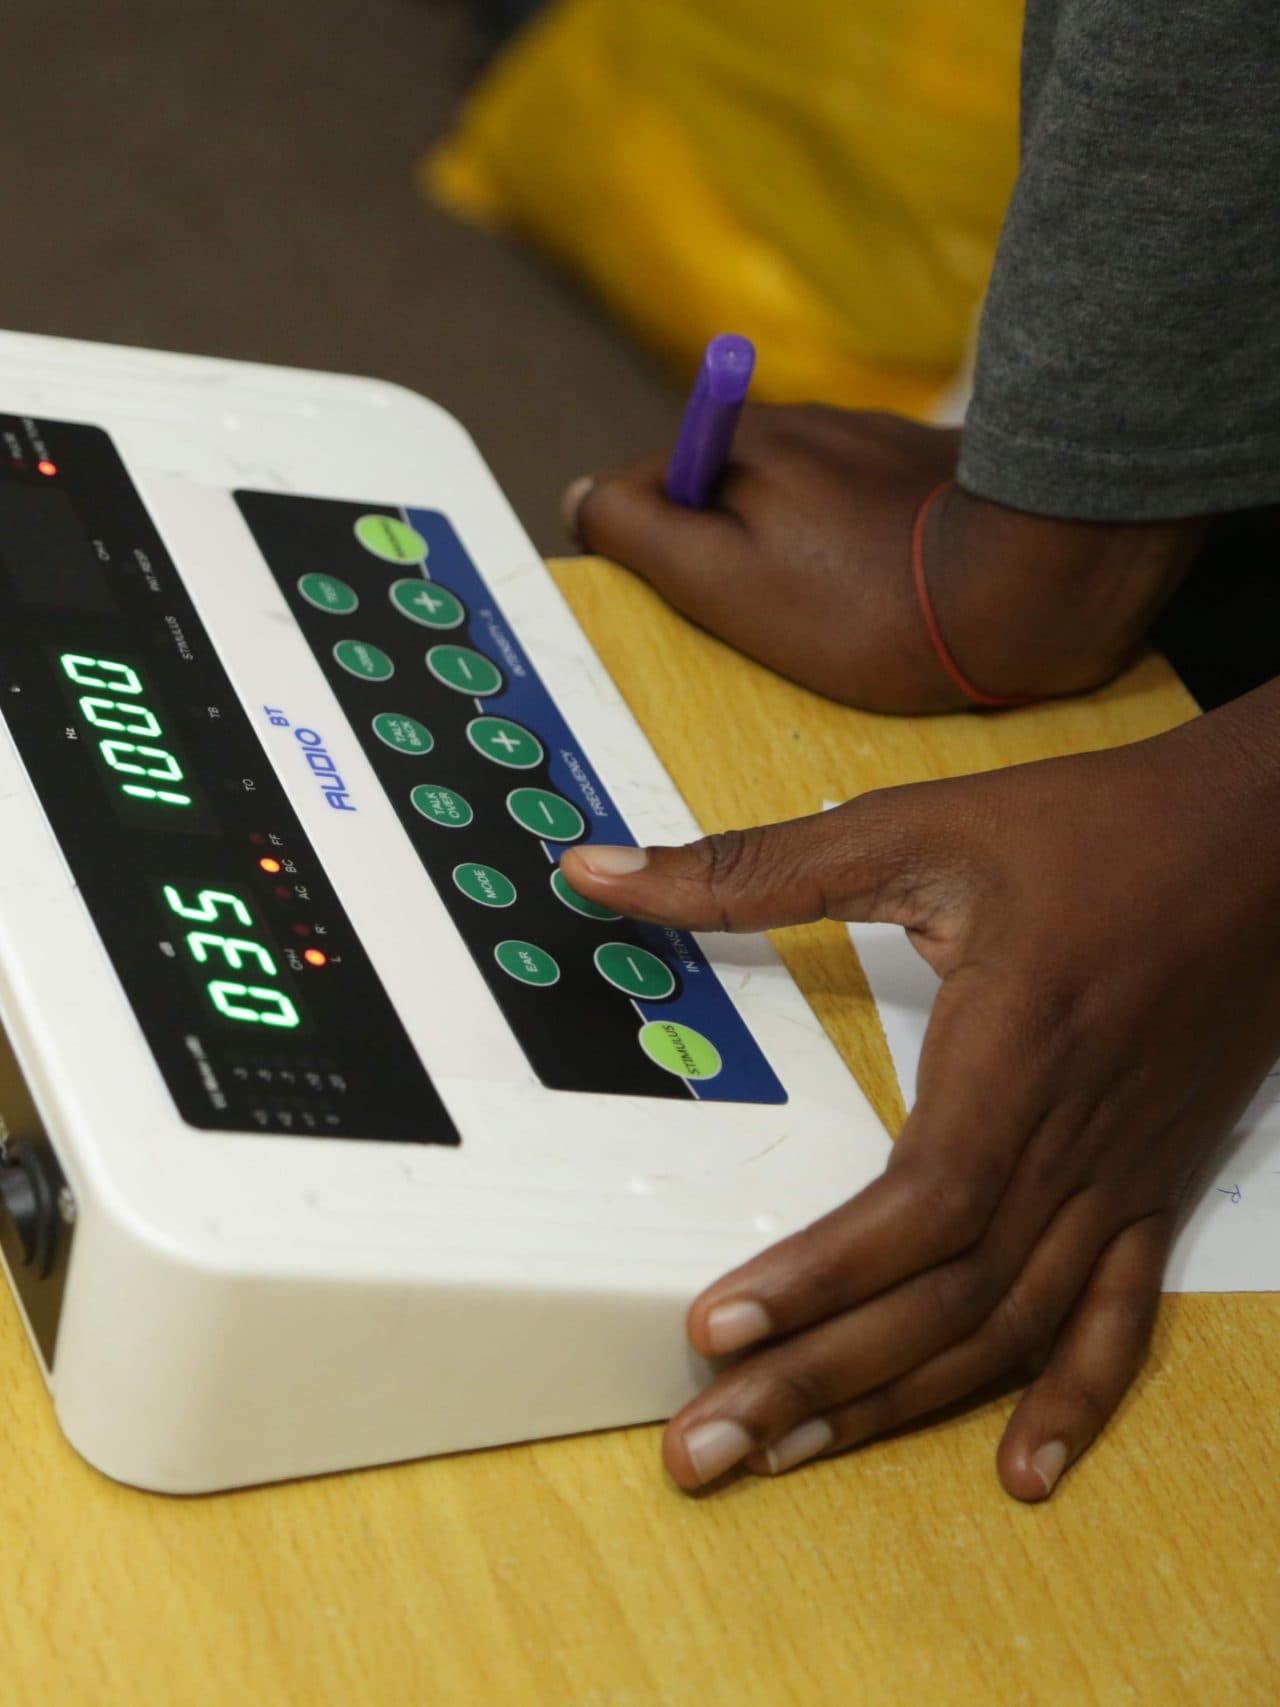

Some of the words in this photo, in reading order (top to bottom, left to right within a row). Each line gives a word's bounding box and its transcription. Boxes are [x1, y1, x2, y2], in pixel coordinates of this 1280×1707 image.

[164, 615, 193, 661] STIMULUS
[207, 706, 220, 718] TB
[263, 704, 291, 728] BT
[60, 653, 191, 806] 1000
[65, 727, 78, 740] Hz
[387, 719, 406, 743] TALK
[401, 720, 422, 746] BACK
[294, 727, 357, 812] AUDIO
[242, 778, 256, 791] TO
[560, 748, 608, 817] FREQUENCY
[425, 791, 445, 815] TALK
[439, 791, 460, 819] OVER
[268, 832, 283, 846] FF
[281, 858, 297, 873] BC
[295, 884, 311, 900] AC
[473, 869, 497, 899] MODE
[163, 884, 300, 1029] 035
[330, 956, 342, 964] L
[518, 951, 538, 972] EAR
[662, 1023, 700, 1076] STIMULUS
